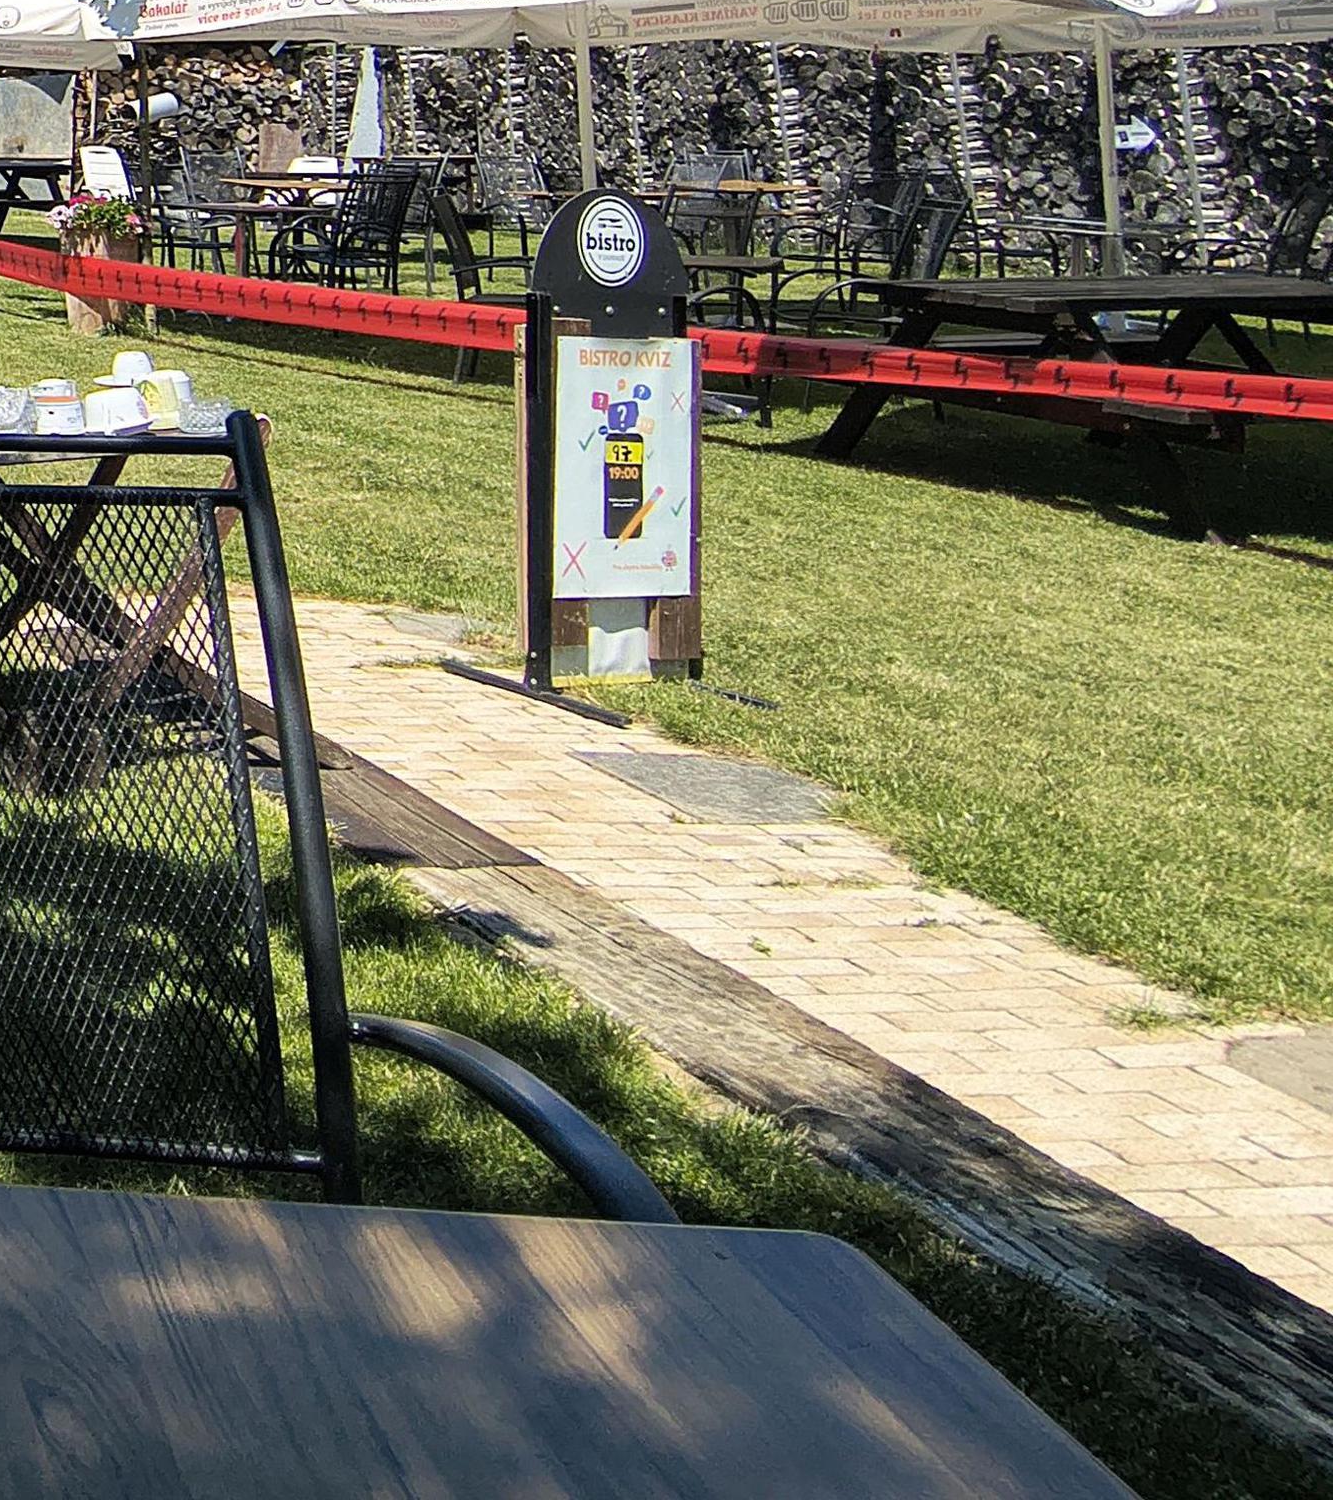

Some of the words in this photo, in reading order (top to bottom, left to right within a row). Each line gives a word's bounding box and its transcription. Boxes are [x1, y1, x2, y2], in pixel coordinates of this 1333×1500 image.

[139, 0, 189, 18] Bakalář
[198, 12, 219, 24] více
[222, 7, 241, 20] než
[586, 232, 636, 252] bistro
[579, 349, 632, 367] BISTRO
[635, 346, 672, 368] KVÍZ
[609, 466, 639, 480] 19:00
